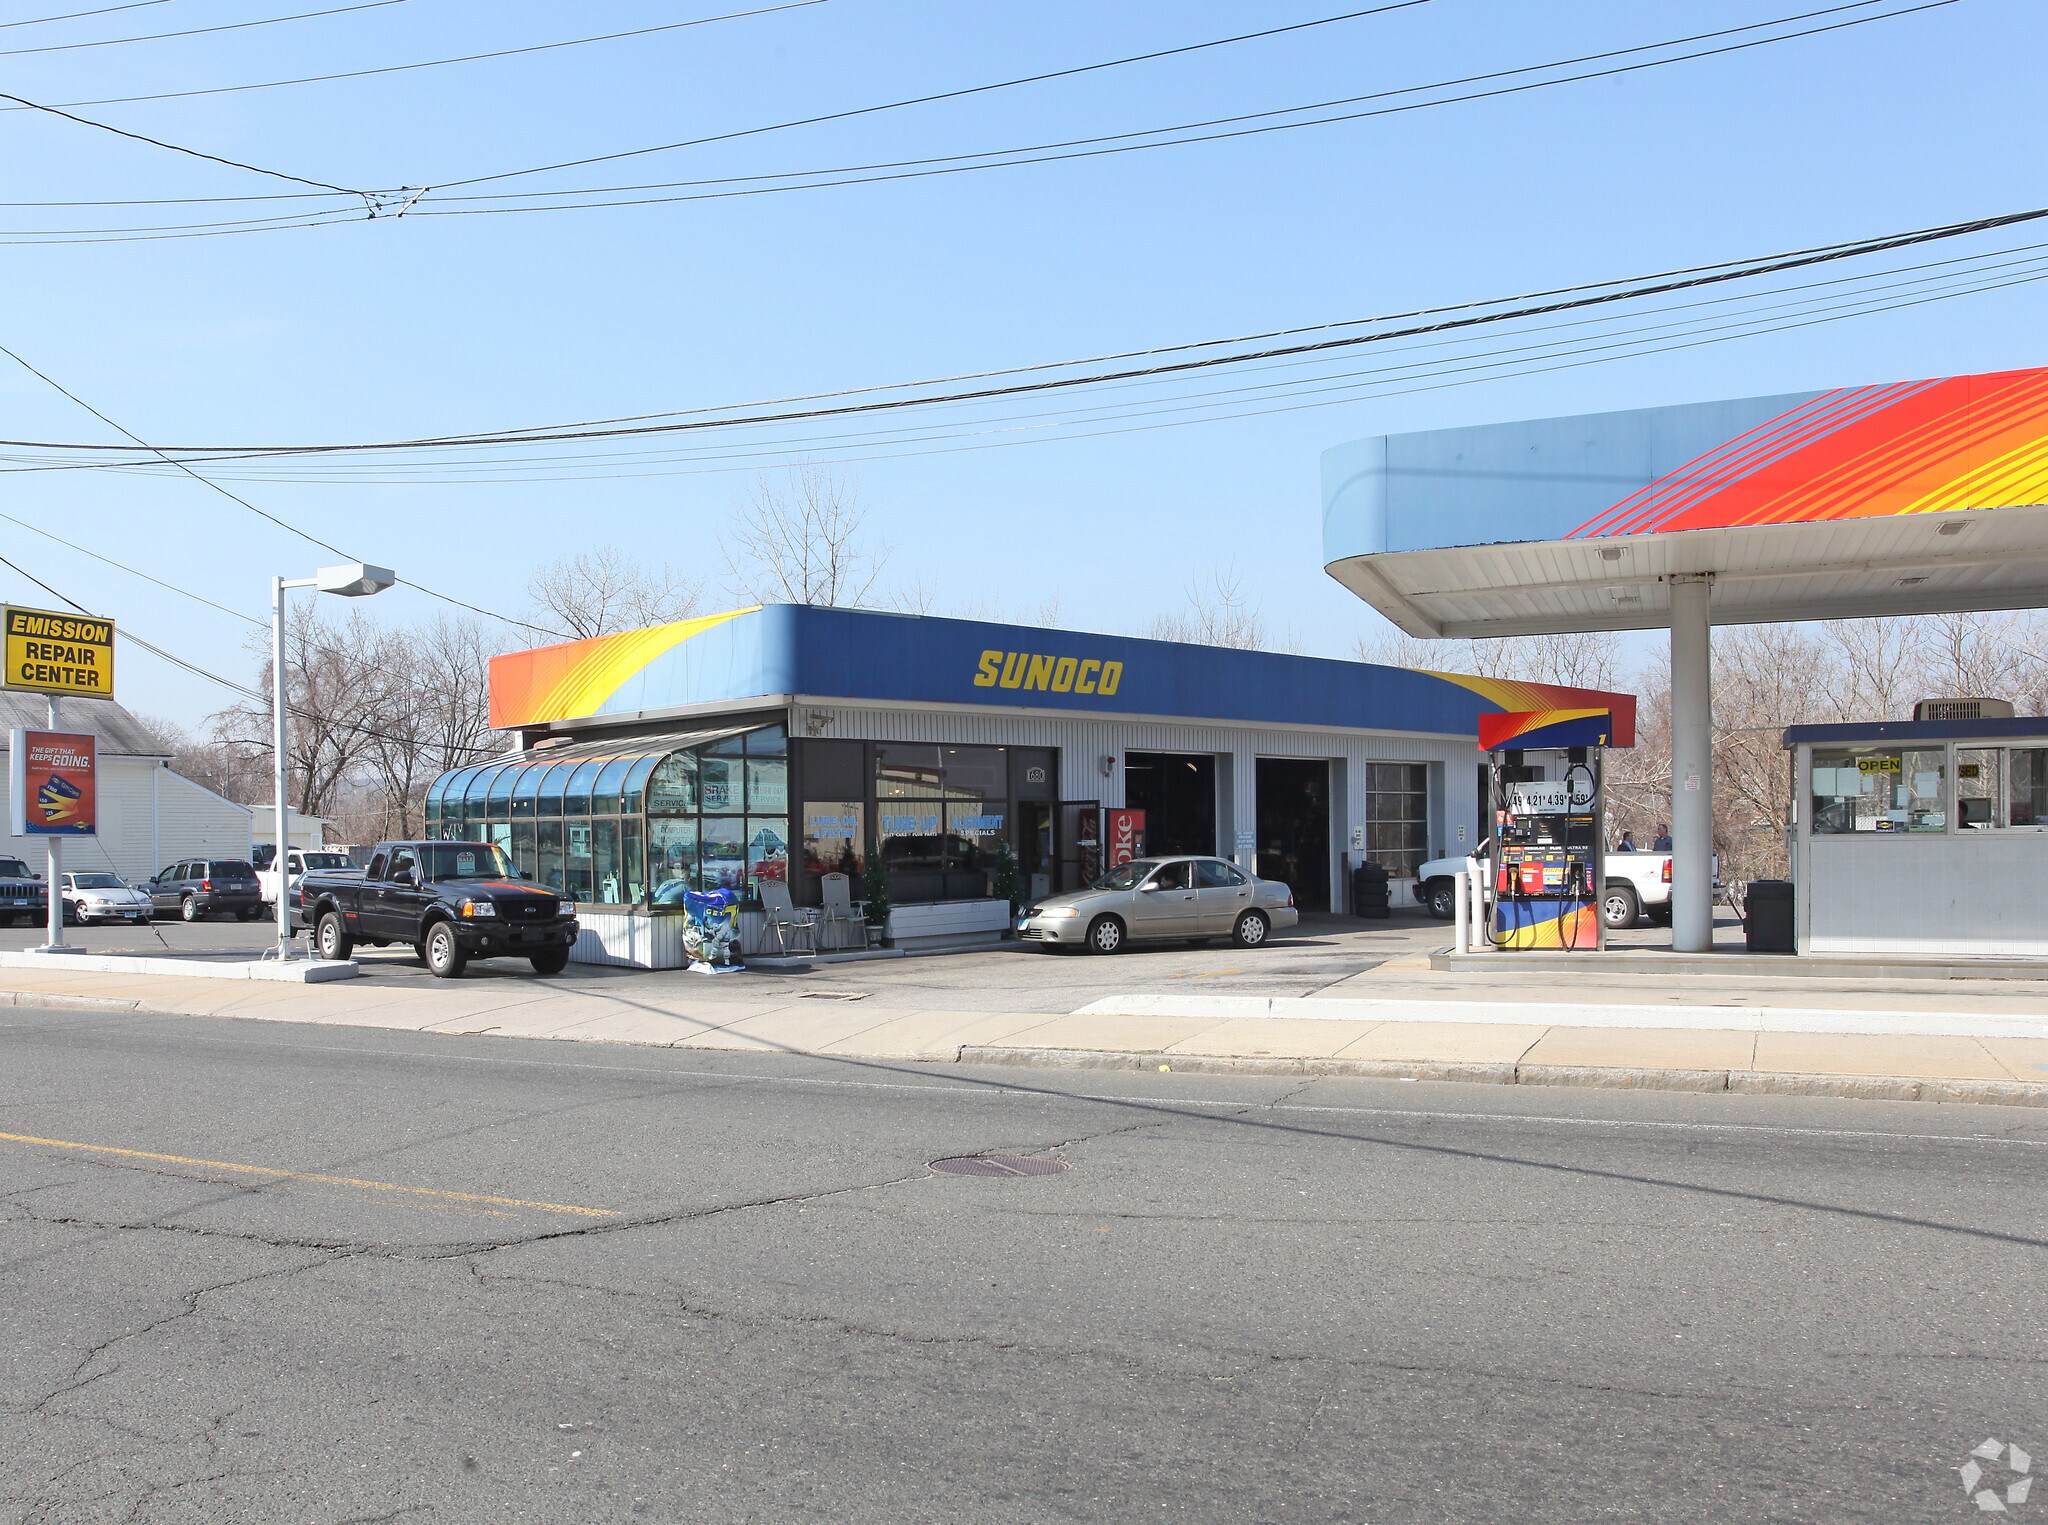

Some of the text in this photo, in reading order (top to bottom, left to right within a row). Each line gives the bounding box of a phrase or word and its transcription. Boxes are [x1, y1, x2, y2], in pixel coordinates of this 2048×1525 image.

[11, 614, 109, 643] EMISSION
[26, 641, 95, 666] REPAIR
[21, 662, 99, 687] CENTER
[973, 649, 1124, 696] SUNOCO
[31, 746, 45, 754] THE
[45, 747, 59, 755] GIFT
[30, 753, 90, 767] KEEPS GOING.
[1858, 759, 1900, 771] OPEN
[704, 785, 739, 795] BRAKE
[881, 815, 938, 832] TUNE-UP
[952, 815, 1004, 830] ALIGNMENT
[820, 827, 856, 839] FILTER
[1115, 814, 1133, 867] oke
